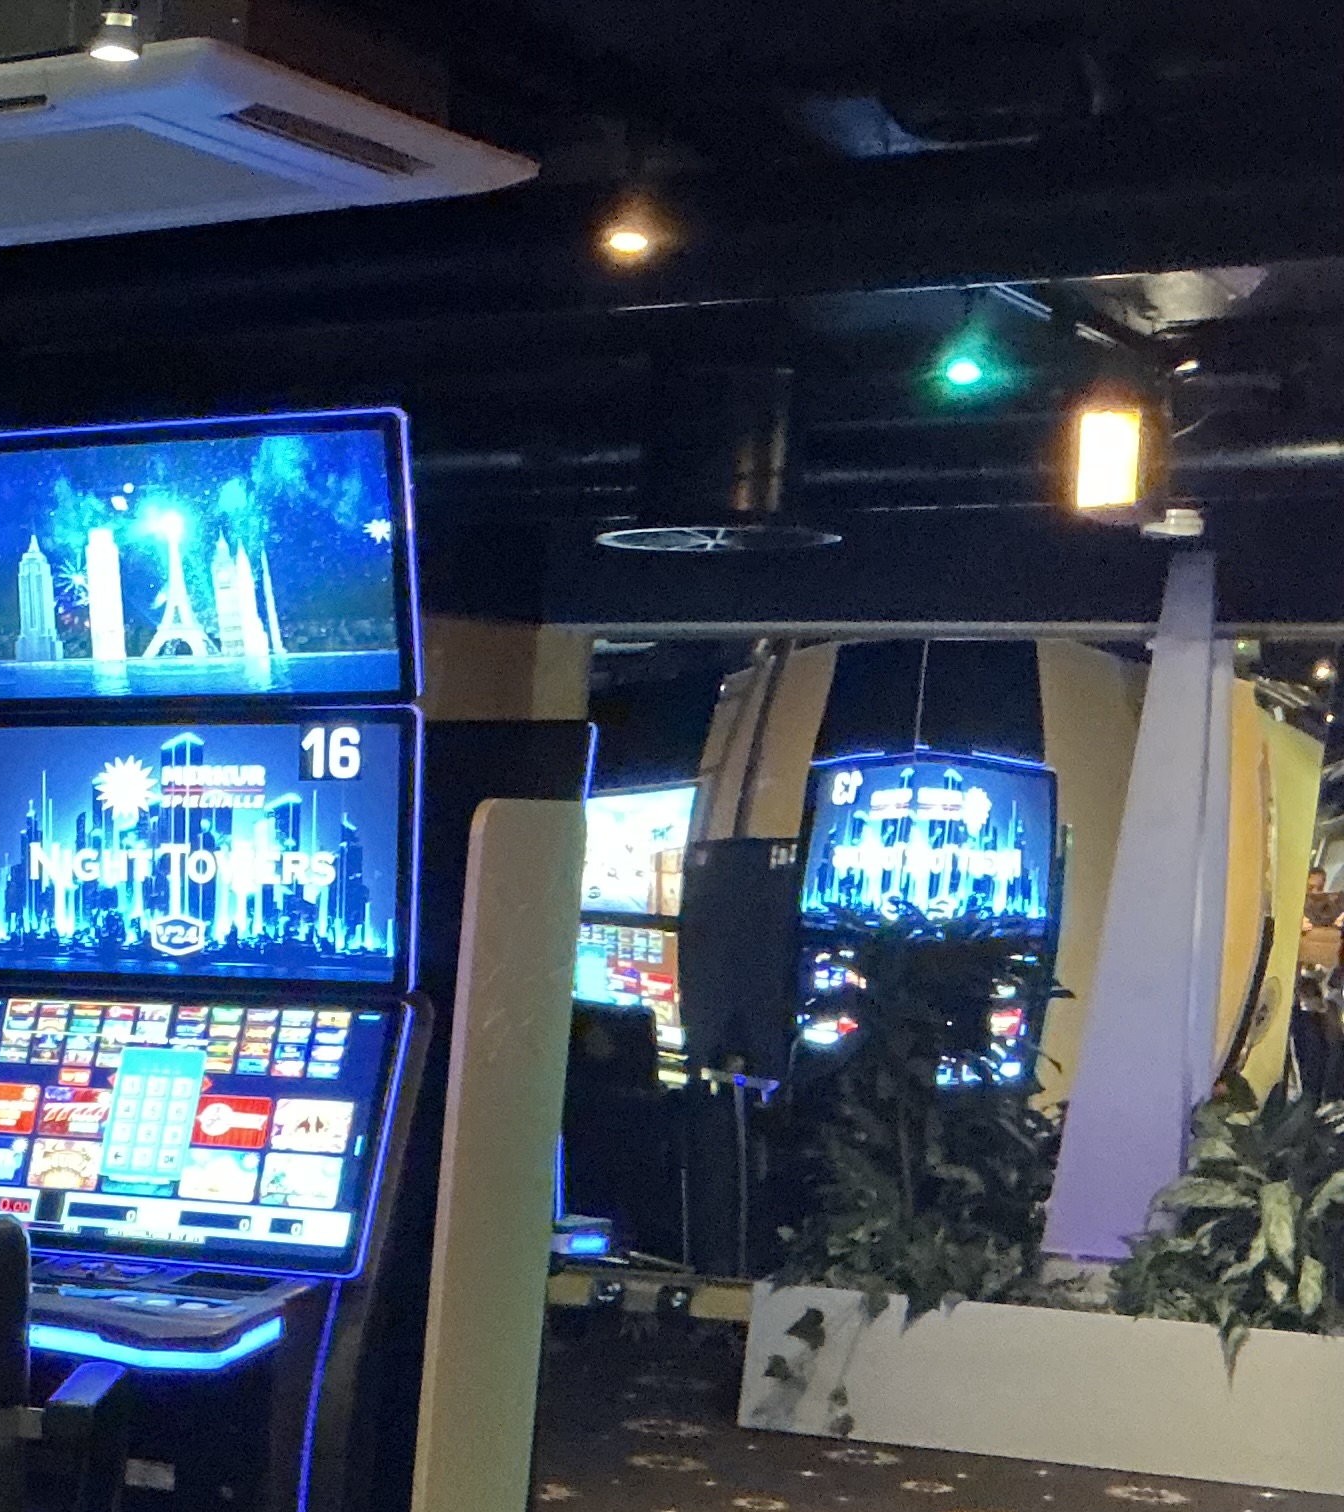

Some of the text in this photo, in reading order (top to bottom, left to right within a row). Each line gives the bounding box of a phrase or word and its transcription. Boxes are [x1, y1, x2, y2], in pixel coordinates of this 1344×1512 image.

[301, 727, 361, 779] 16
[29, 843, 337, 886] NIGHT TOWERS
